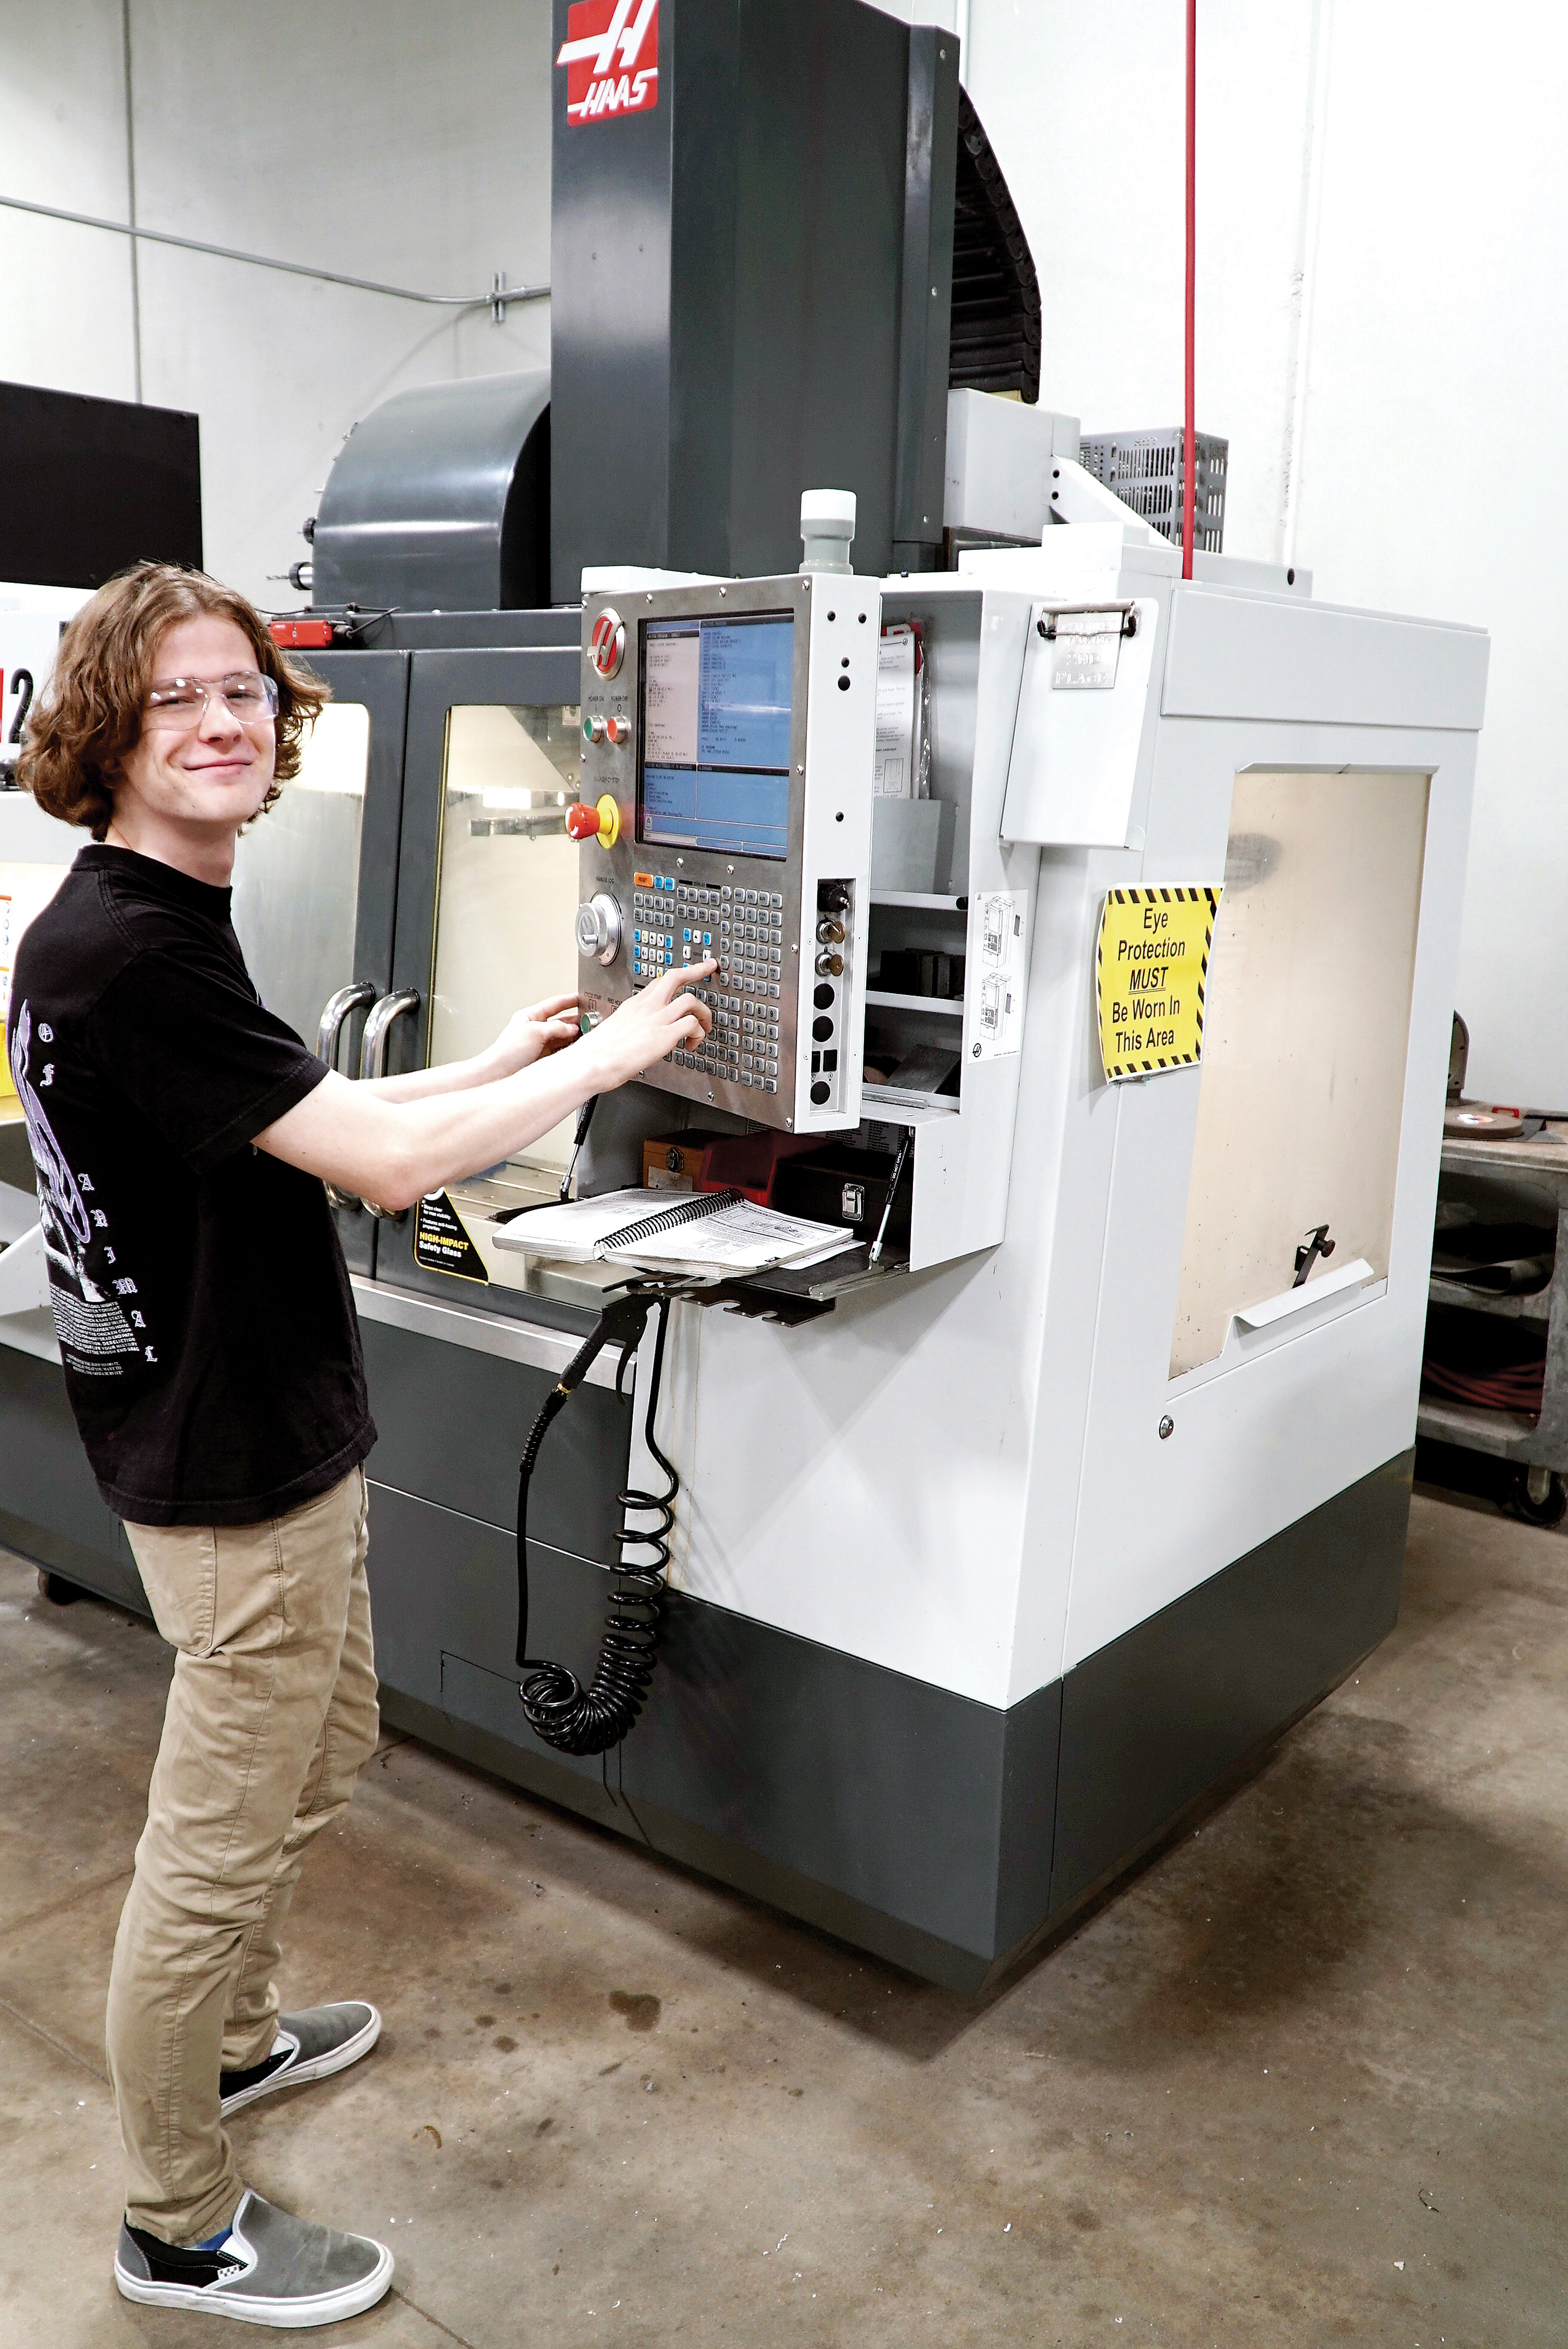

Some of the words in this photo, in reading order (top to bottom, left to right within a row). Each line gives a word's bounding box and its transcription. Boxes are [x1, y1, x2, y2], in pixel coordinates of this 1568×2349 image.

[567, 67, 658, 117] HAAS
[1055, 670, 1108, 685] PLACE
[1143, 908, 1169, 934] Eye
[1117, 937, 1185, 961] Protection
[1129, 966, 1169, 992] MUST
[1112, 1001, 1128, 1024] Be
[1132, 999, 1166, 1019] Worn
[1170, 994, 1180, 1015] In
[1115, 1030, 1143, 1053] This
[1146, 1027, 1175, 1048] Area
[423, 1218, 438, 1226] Features
[419, 1231, 469, 1251] HIGH-IMPACT
[419, 1240, 441, 1254] Safety
[442, 1246, 462, 1258] Glass
[102, 1337, 136, 1346] DERELICTION
